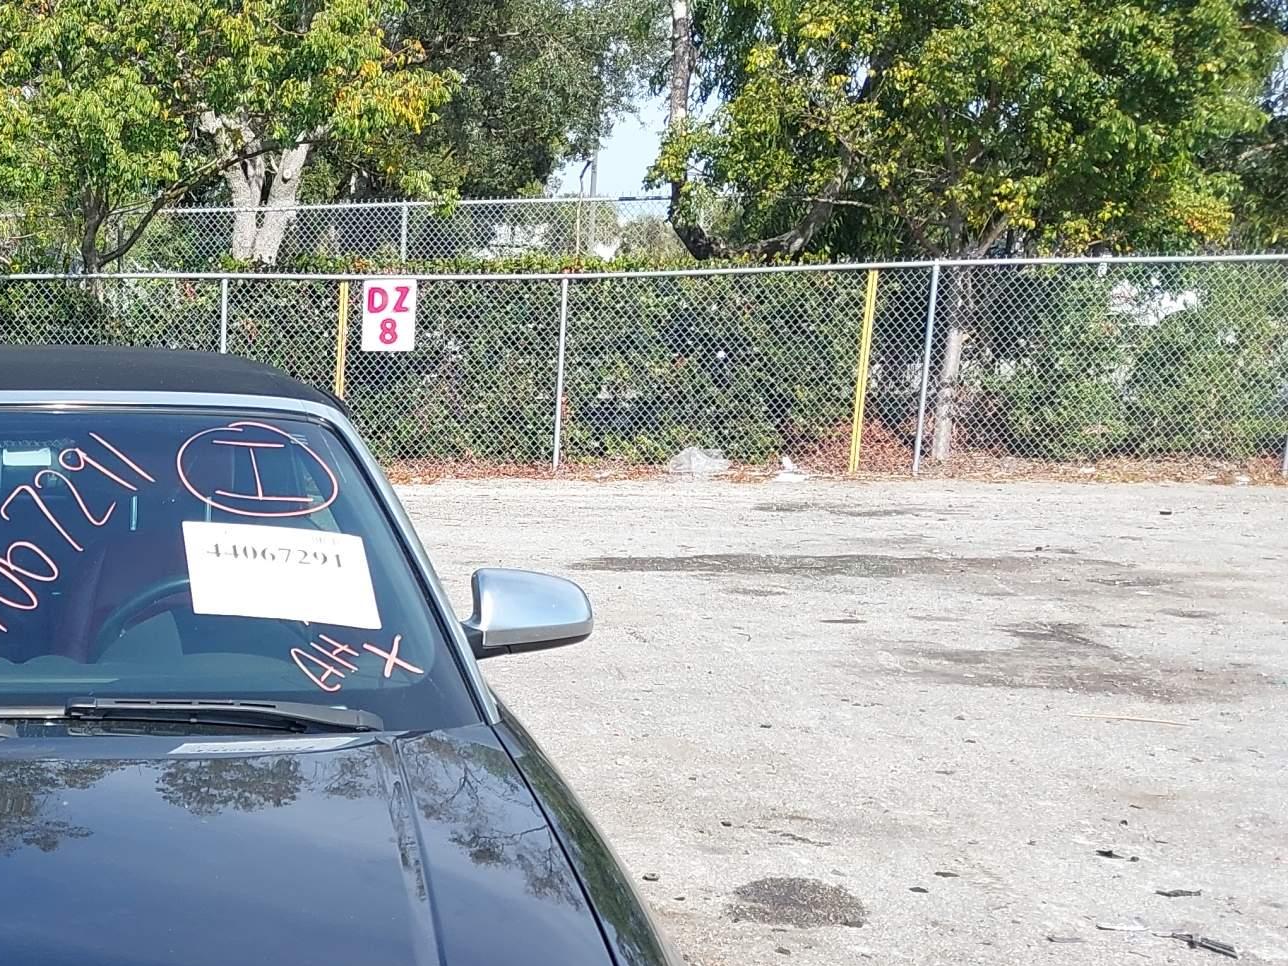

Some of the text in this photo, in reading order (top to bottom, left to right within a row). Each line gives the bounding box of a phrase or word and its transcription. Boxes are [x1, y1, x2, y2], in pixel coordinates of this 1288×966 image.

[367, 286, 410, 314] DZ
[379, 318, 398, 345] 8
[206, 542, 343, 568] 44067291
[362, 634, 425, 678] X
